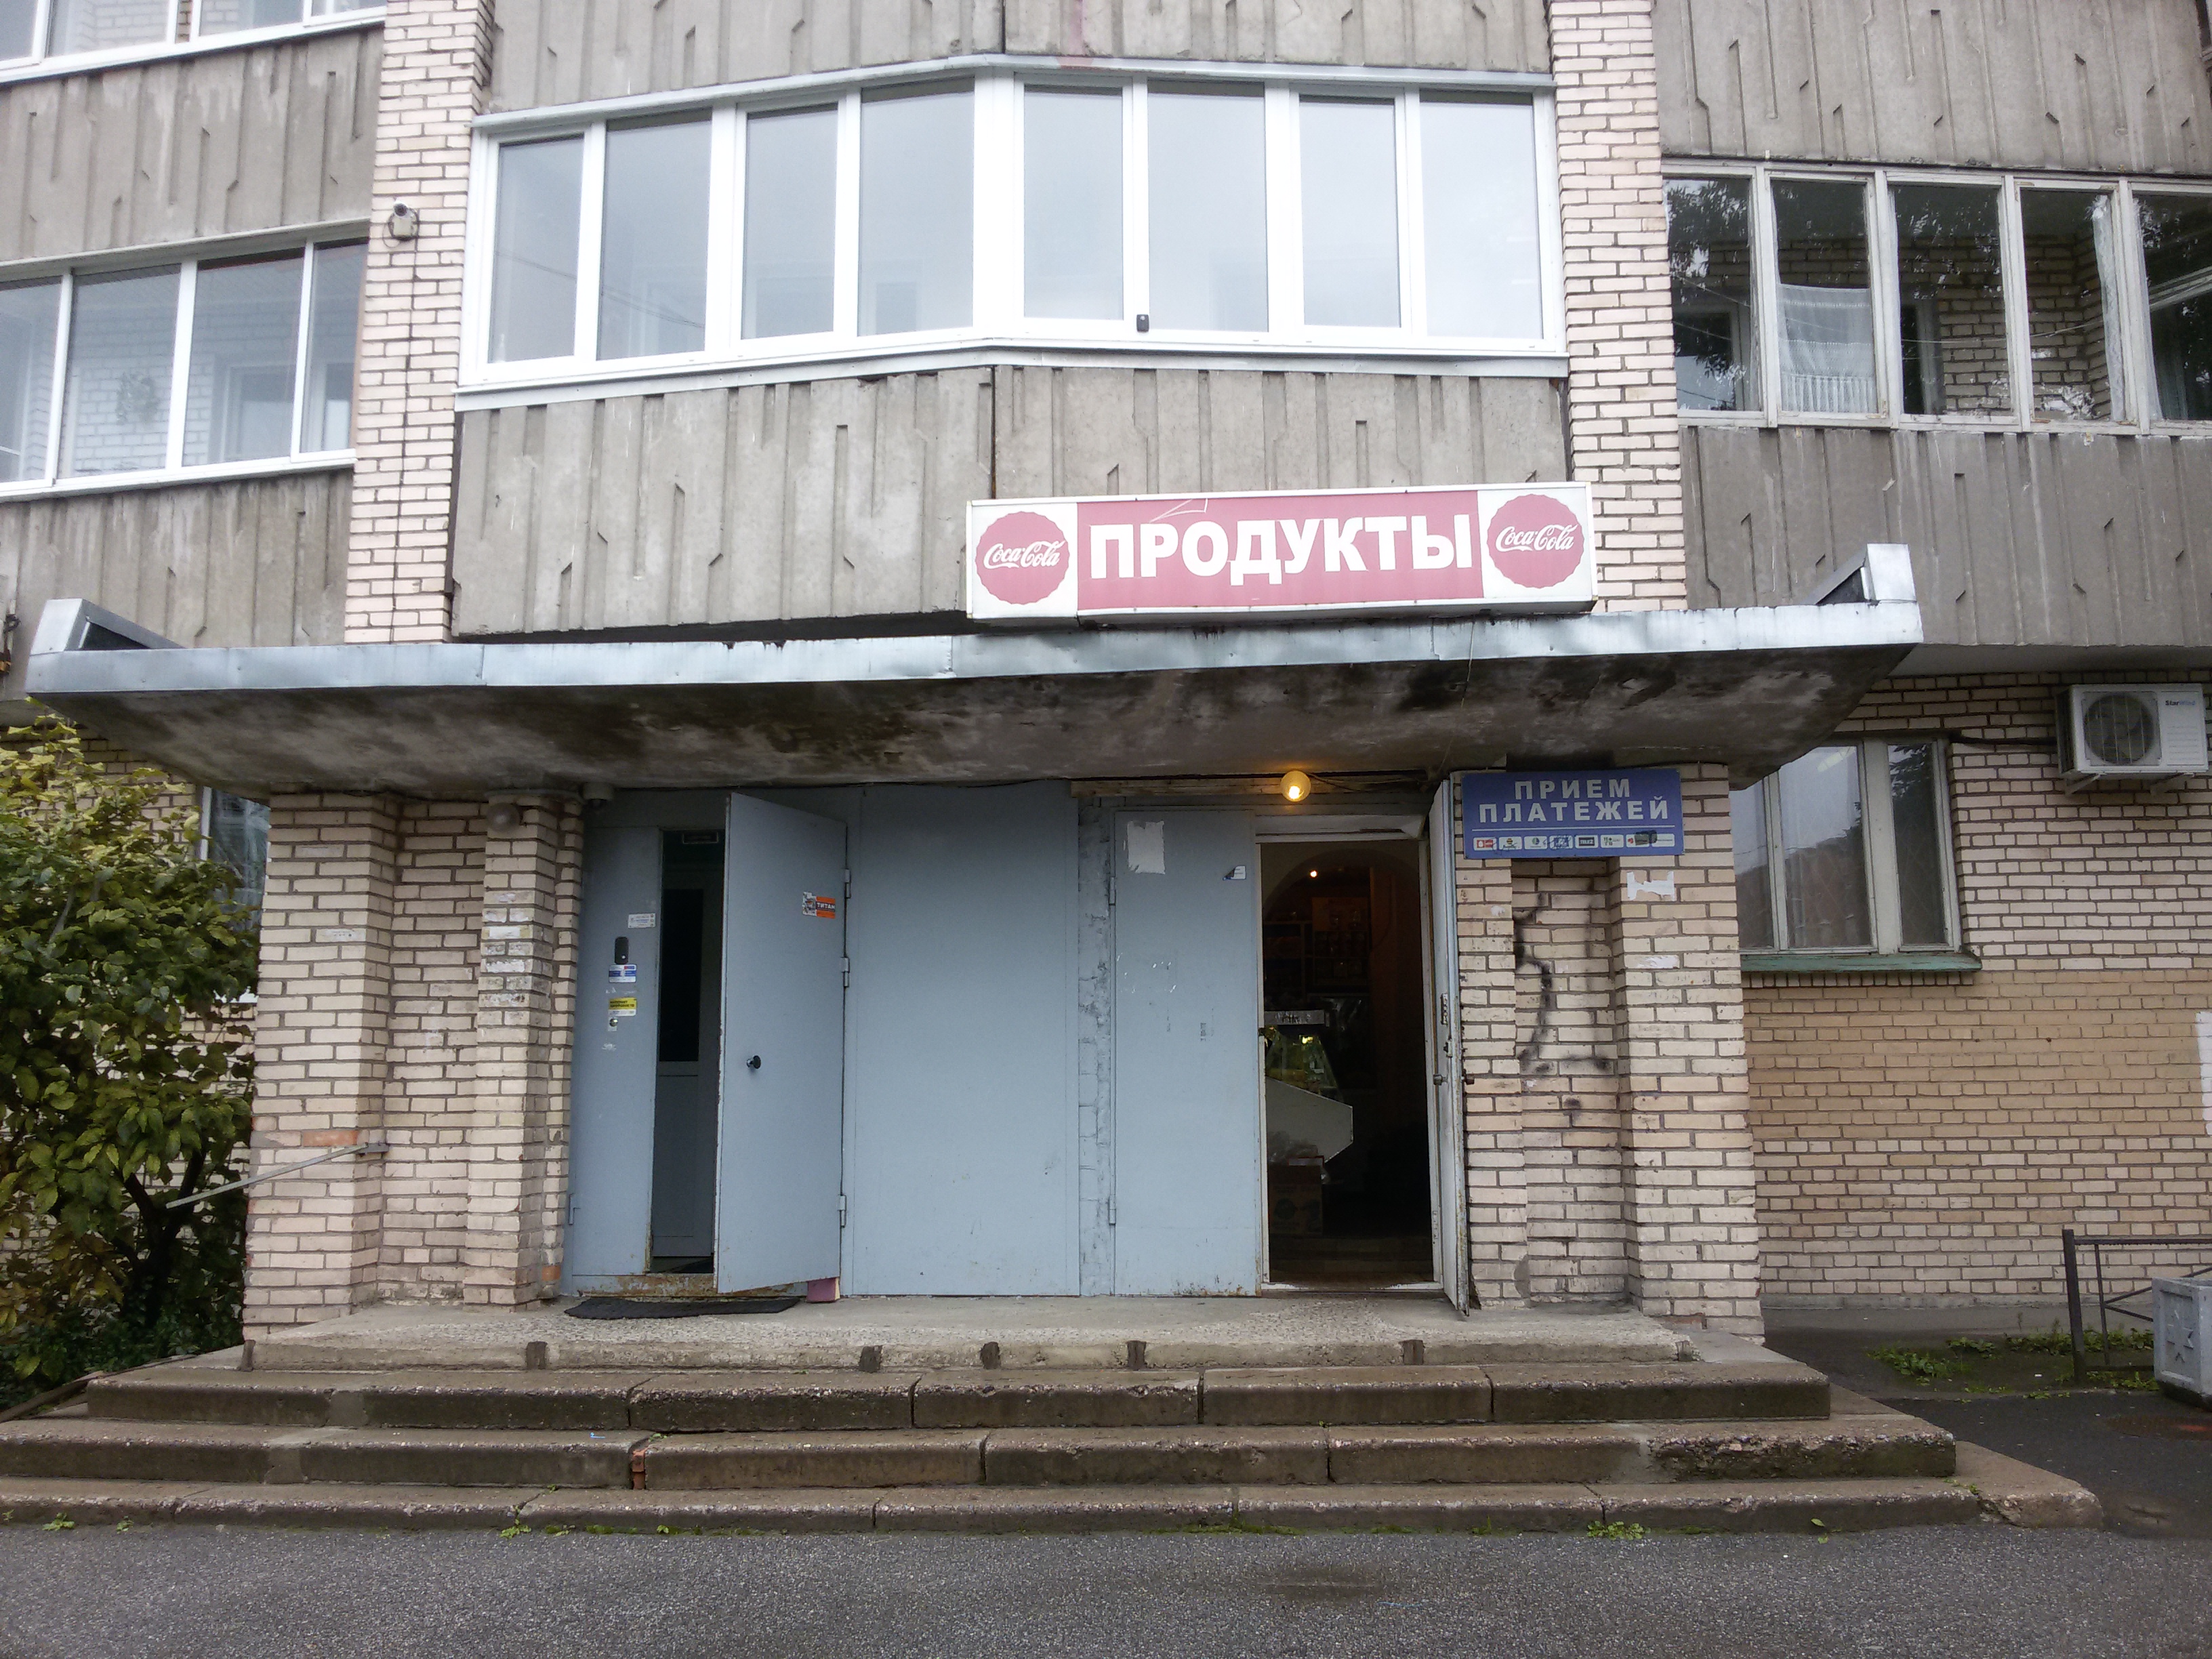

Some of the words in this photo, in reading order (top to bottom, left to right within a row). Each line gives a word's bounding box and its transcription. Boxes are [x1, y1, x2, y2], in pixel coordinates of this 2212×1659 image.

[1090, 514, 1473, 586] ПРОДУКТЫ
[1496, 524, 1579, 552] Coca-Cola
[983, 540, 1066, 569] Coca-Cola
[1515, 778, 1630, 800] ПРИЕМ
[1479, 796, 1668, 823] ПЛАТЕЖЕЙ
